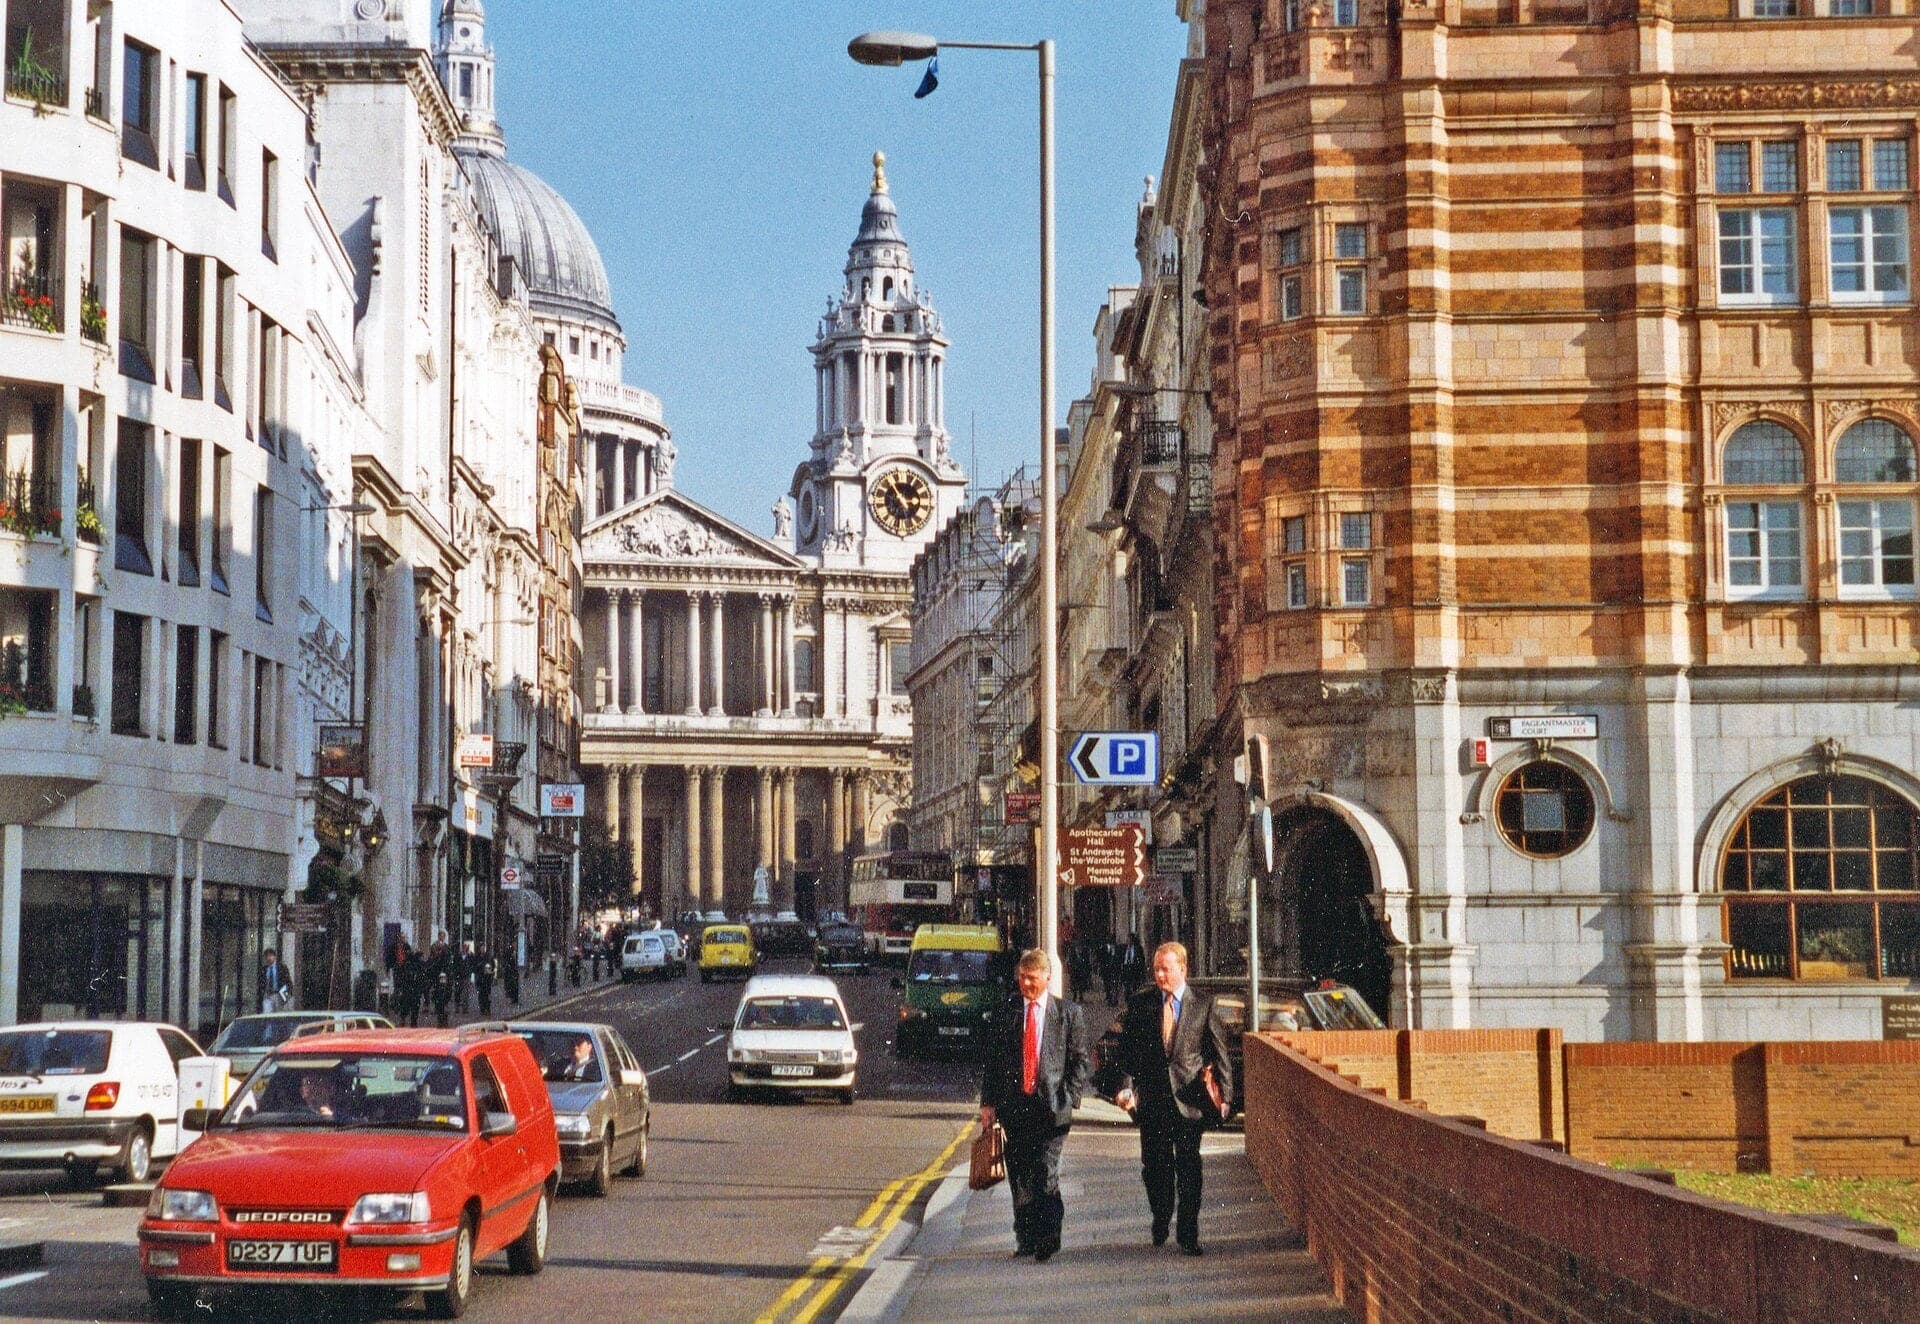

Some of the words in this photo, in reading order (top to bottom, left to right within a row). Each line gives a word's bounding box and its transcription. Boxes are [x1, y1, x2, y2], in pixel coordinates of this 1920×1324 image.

[1521, 719, 1586, 727] PAGEANTMASTER
[1521, 727, 1547, 735] COURT
[1117, 743, 1140, 773] P
[1086, 837, 1105, 846] Hall
[1070, 847, 1080, 856] St
[1086, 866, 1123, 875] Mermaid
[1089, 875, 1121, 884] Theatre
[235, 1212, 331, 1223] BEDFORD
[230, 1243, 285, 1261] D237
[288, 1243, 331, 1261] TUF
